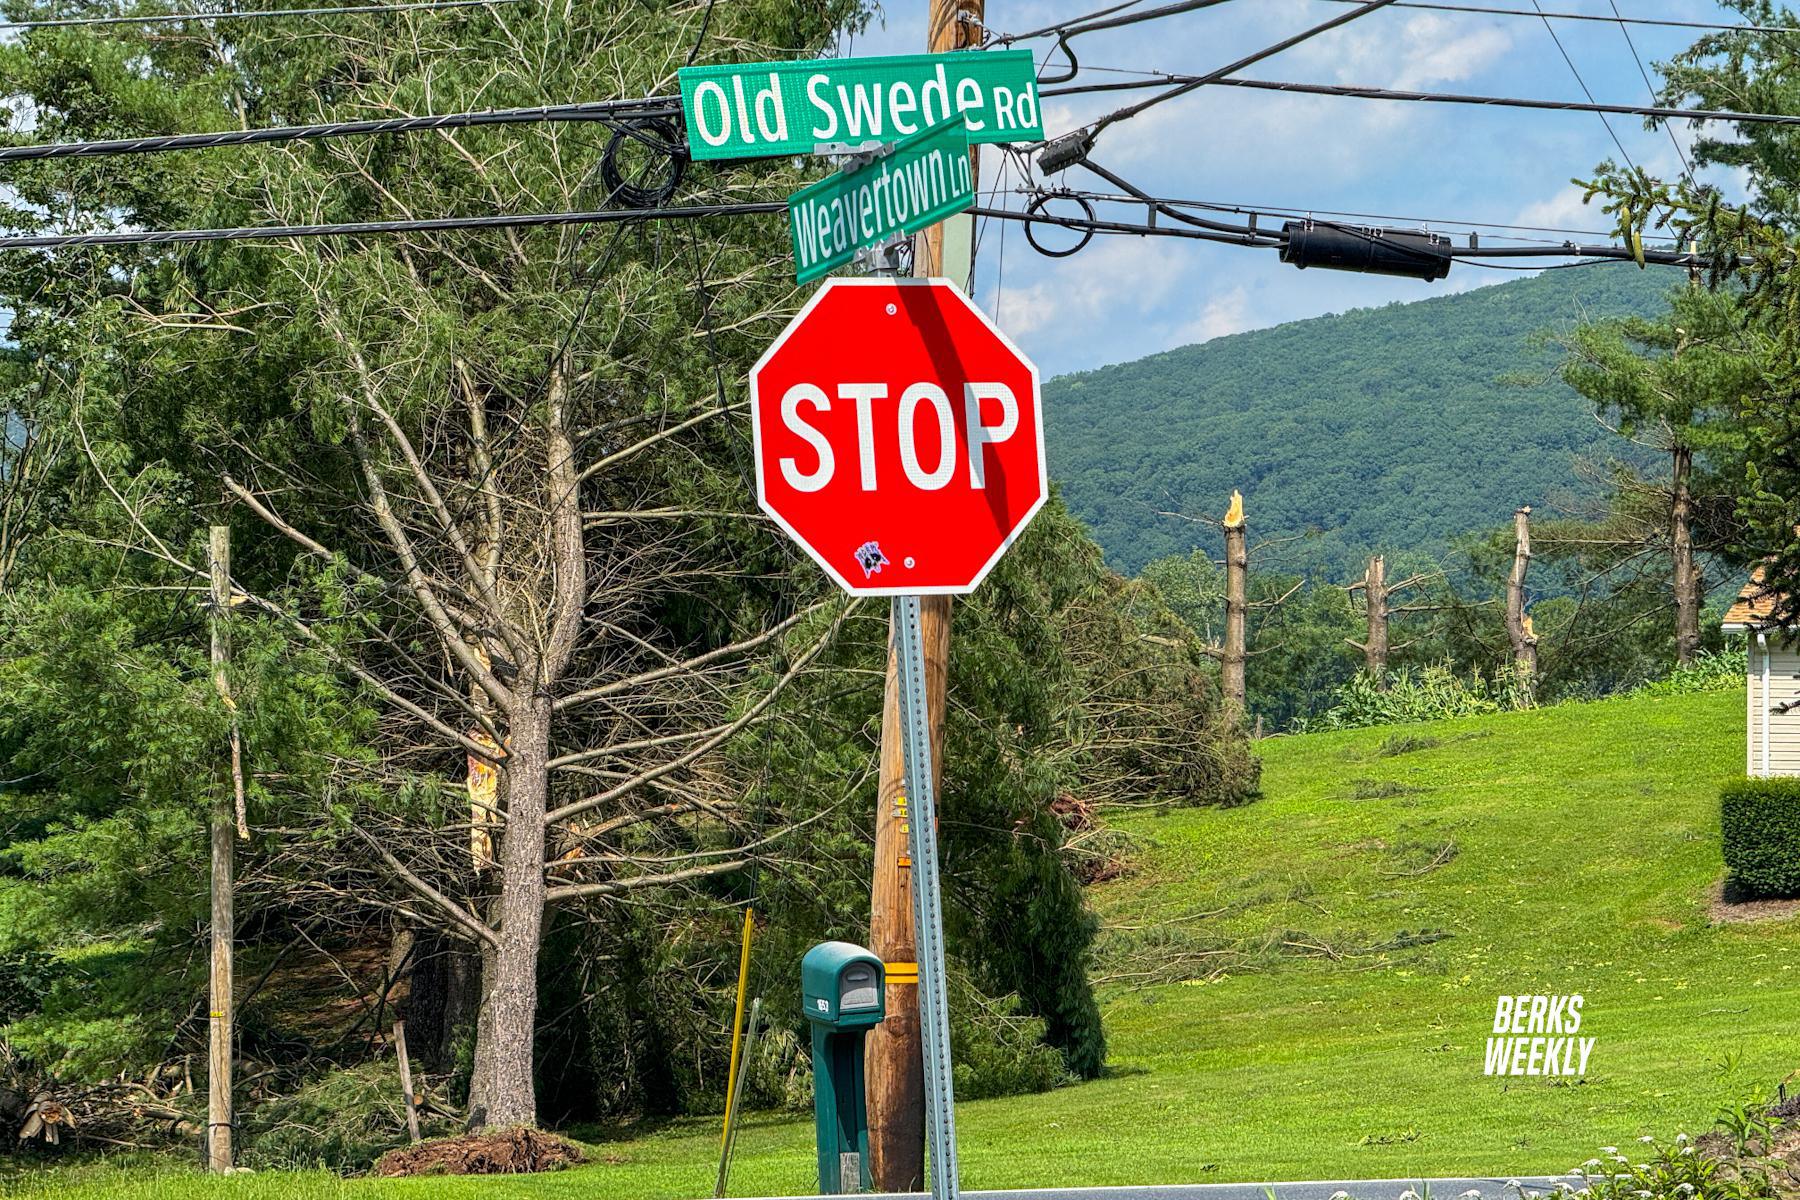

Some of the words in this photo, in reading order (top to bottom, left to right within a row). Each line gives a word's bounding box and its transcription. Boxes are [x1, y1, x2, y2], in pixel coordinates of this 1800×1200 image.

[693, 73, 788, 146] Old
[807, 64, 984, 139] Swede
[993, 82, 1039, 129] Rd
[793, 149, 946, 267] Weavertown
[948, 153, 971, 199] Ln
[779, 382, 1019, 492] STOP
